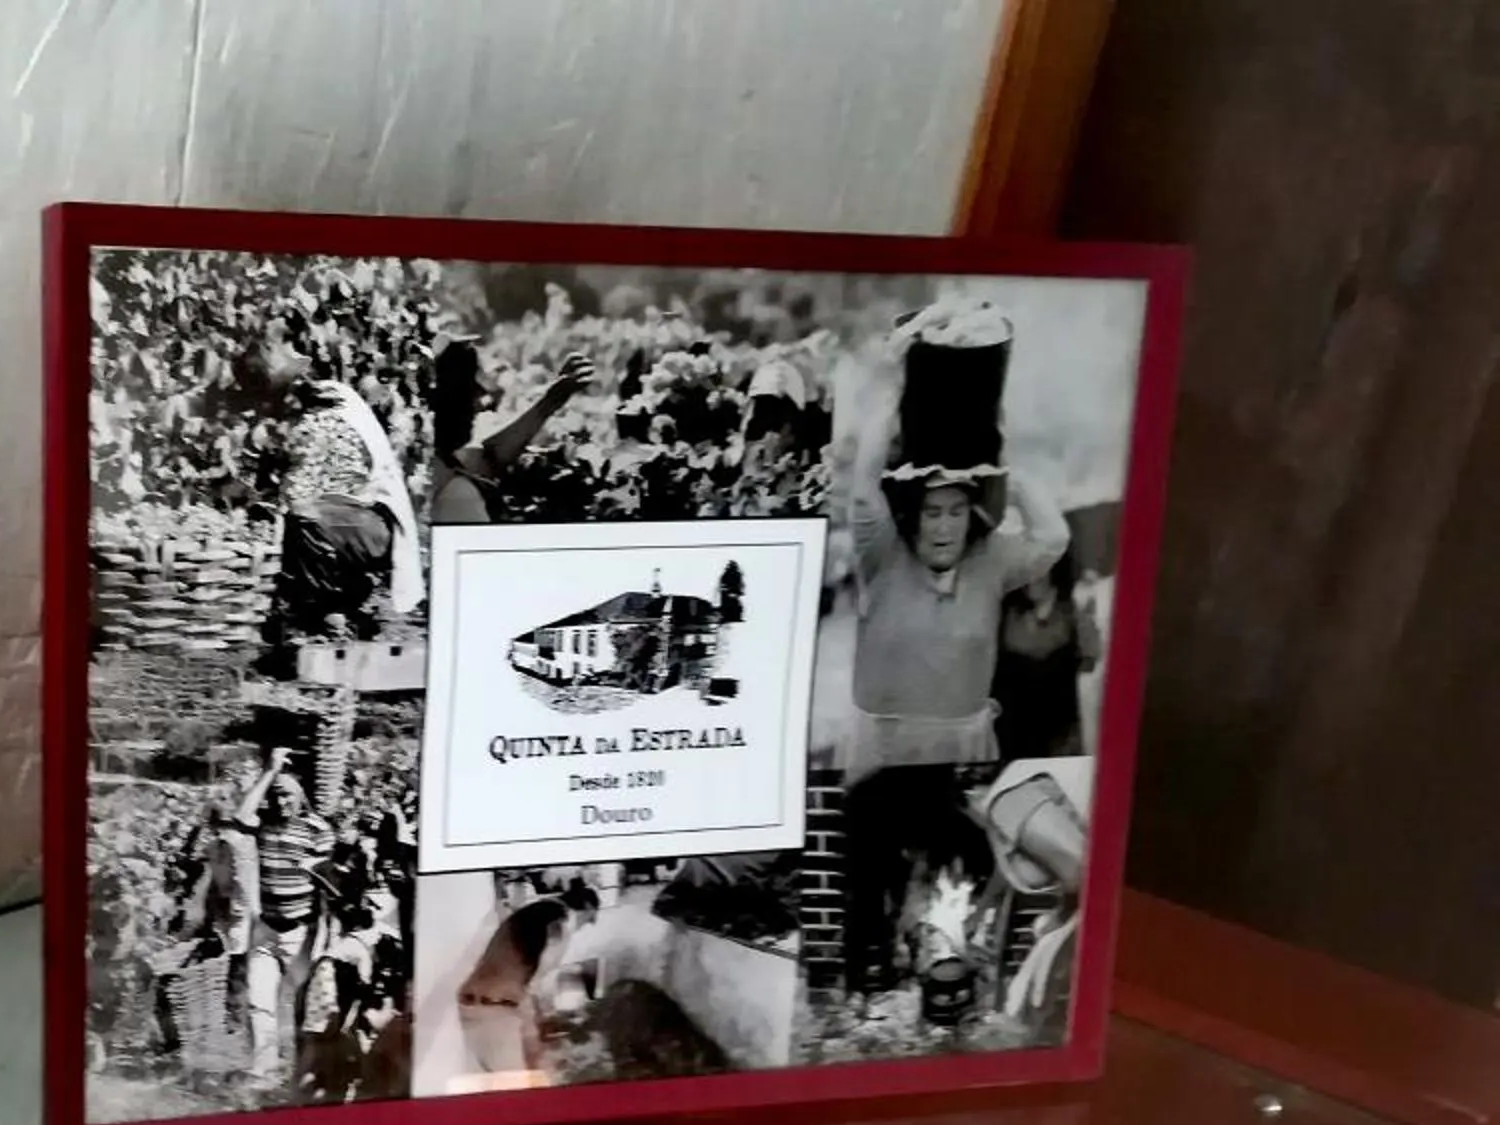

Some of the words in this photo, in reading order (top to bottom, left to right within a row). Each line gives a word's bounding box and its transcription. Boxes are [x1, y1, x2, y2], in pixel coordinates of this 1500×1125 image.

[489, 735, 587, 764] QUINTA
[629, 727, 746, 752] ESTRADA
[569, 774, 621, 791] Desde
[581, 805, 652, 824] Douro
